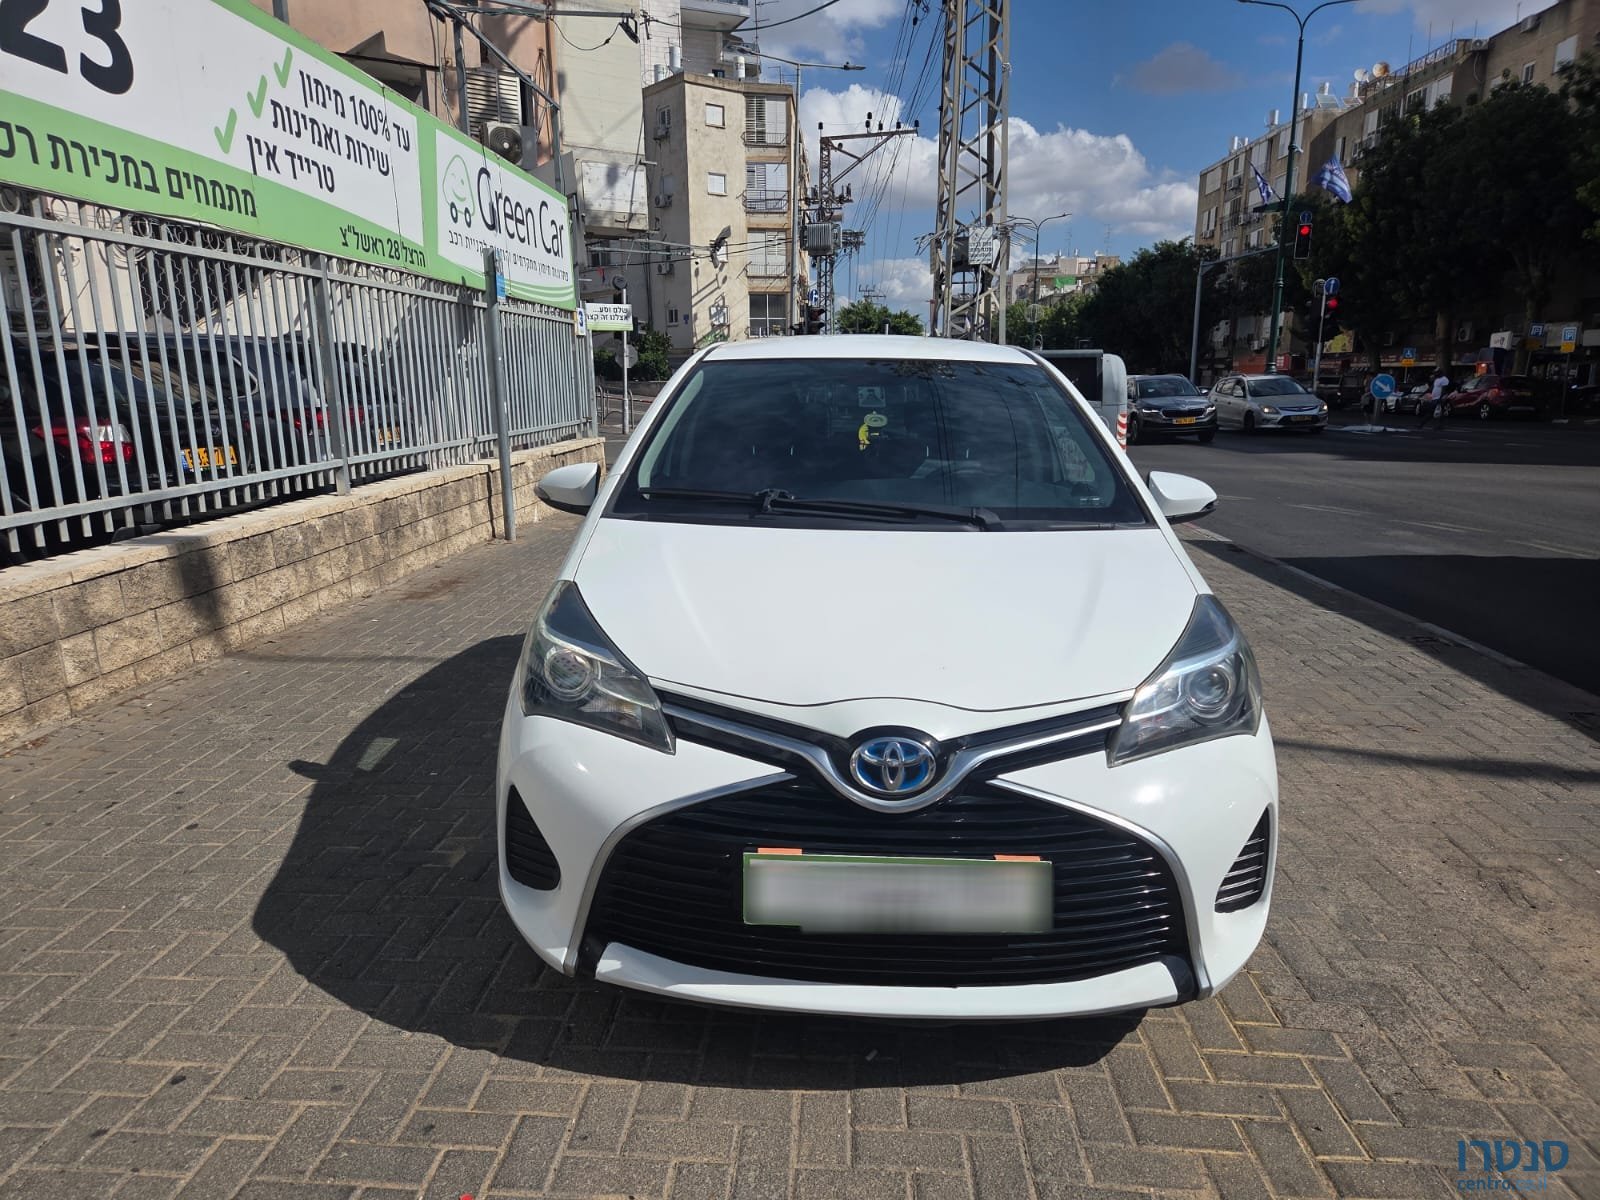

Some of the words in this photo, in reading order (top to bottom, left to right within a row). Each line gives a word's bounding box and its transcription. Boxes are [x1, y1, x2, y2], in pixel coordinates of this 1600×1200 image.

[299, 69, 346, 119] מימון
[270, 99, 341, 156] ואמינות
[349, 95, 391, 142] 100%
[392, 122, 410, 152] עד
[47, 133, 160, 194] במכירת
[246, 134, 281, 176] אין
[284, 149, 335, 193] טרייד
[345, 134, 390, 176] שירות
[165, 167, 258, 218] מתמחים
[477, 166, 538, 249] Green
[539, 200, 564, 259] Car
[387, 237, 401, 261] 28
[401, 241, 426, 268] הרצל
[448, 230, 463, 247] רכב
[613, 306, 628, 314] שלם
